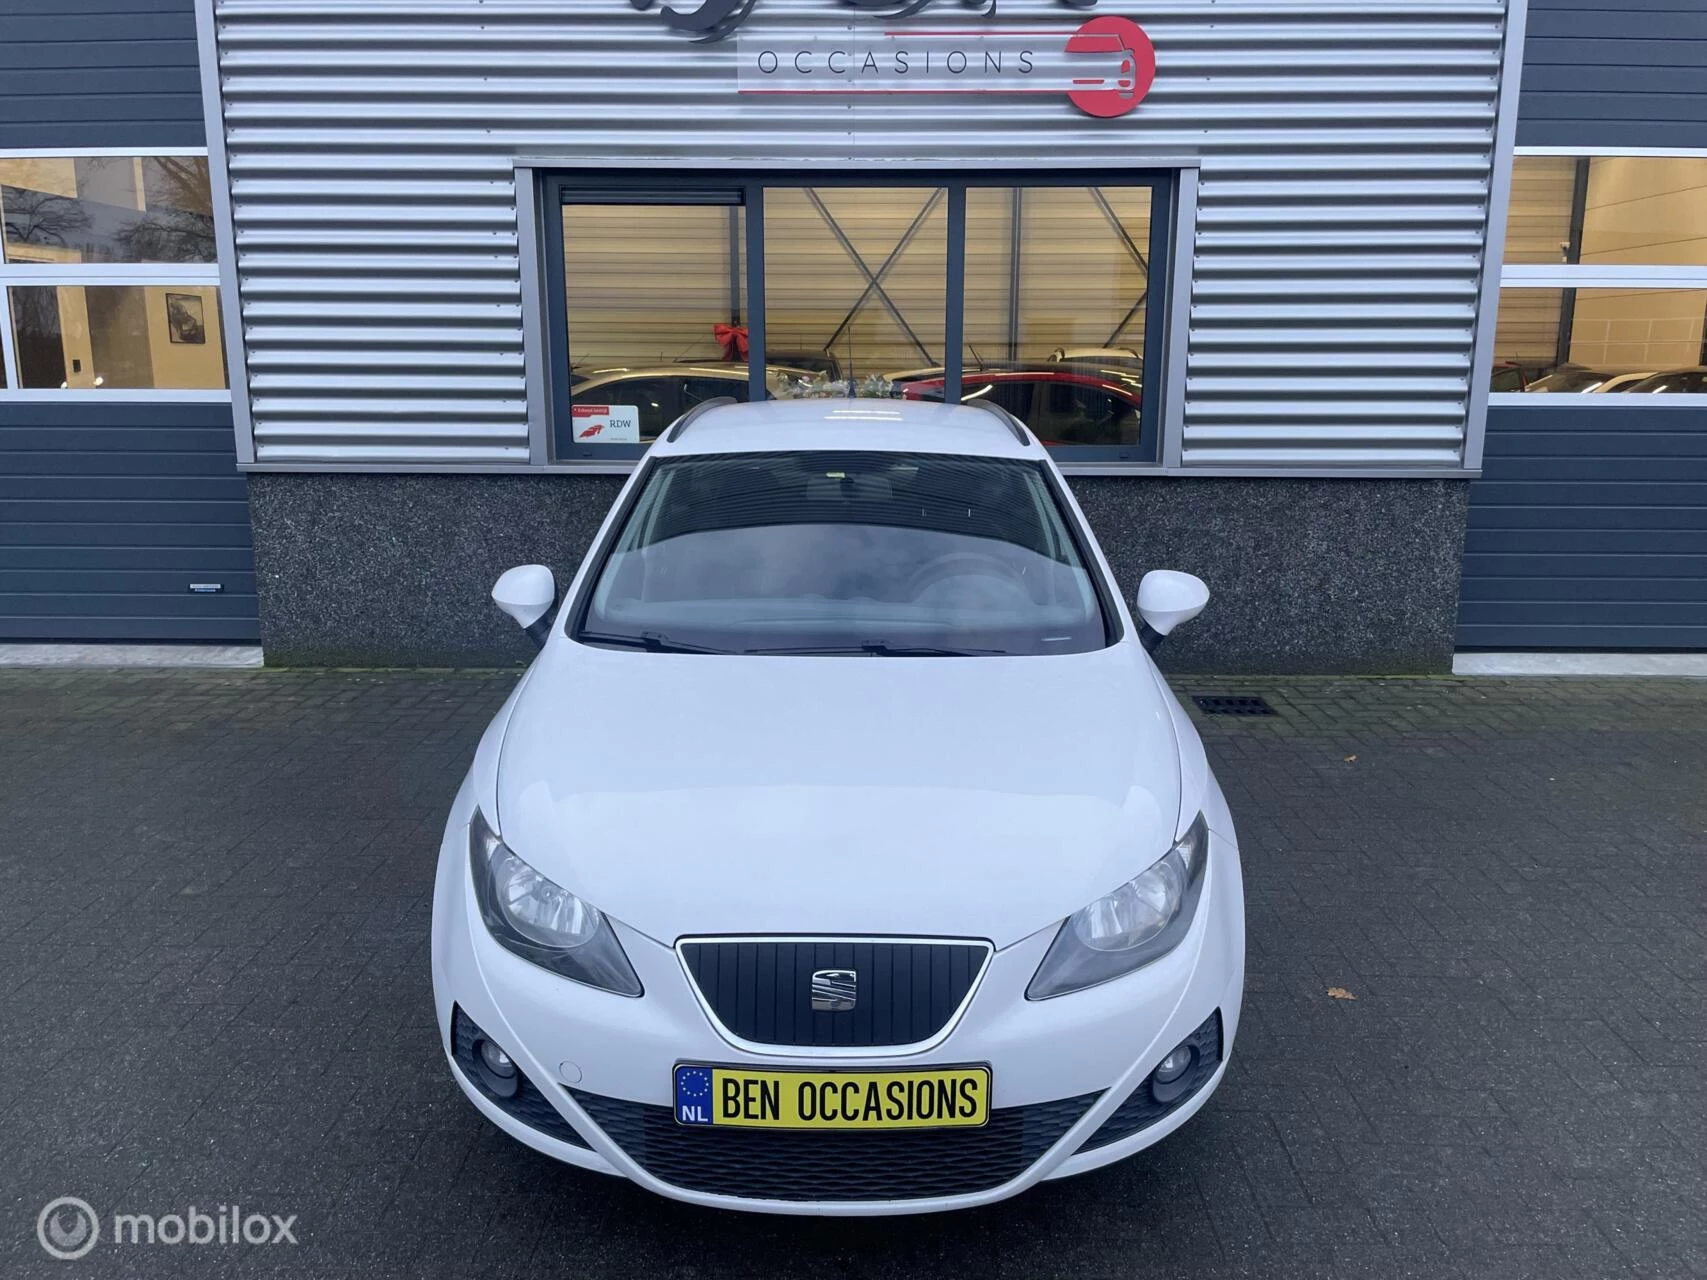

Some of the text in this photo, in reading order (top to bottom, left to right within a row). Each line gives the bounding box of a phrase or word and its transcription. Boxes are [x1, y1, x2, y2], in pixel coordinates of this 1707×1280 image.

[757, 50, 1035, 75] OCCASIONS
[609, 419, 631, 428] RDW
[722, 1078, 978, 1121] BEN OCCASIONS
[682, 1105, 709, 1122] NL
